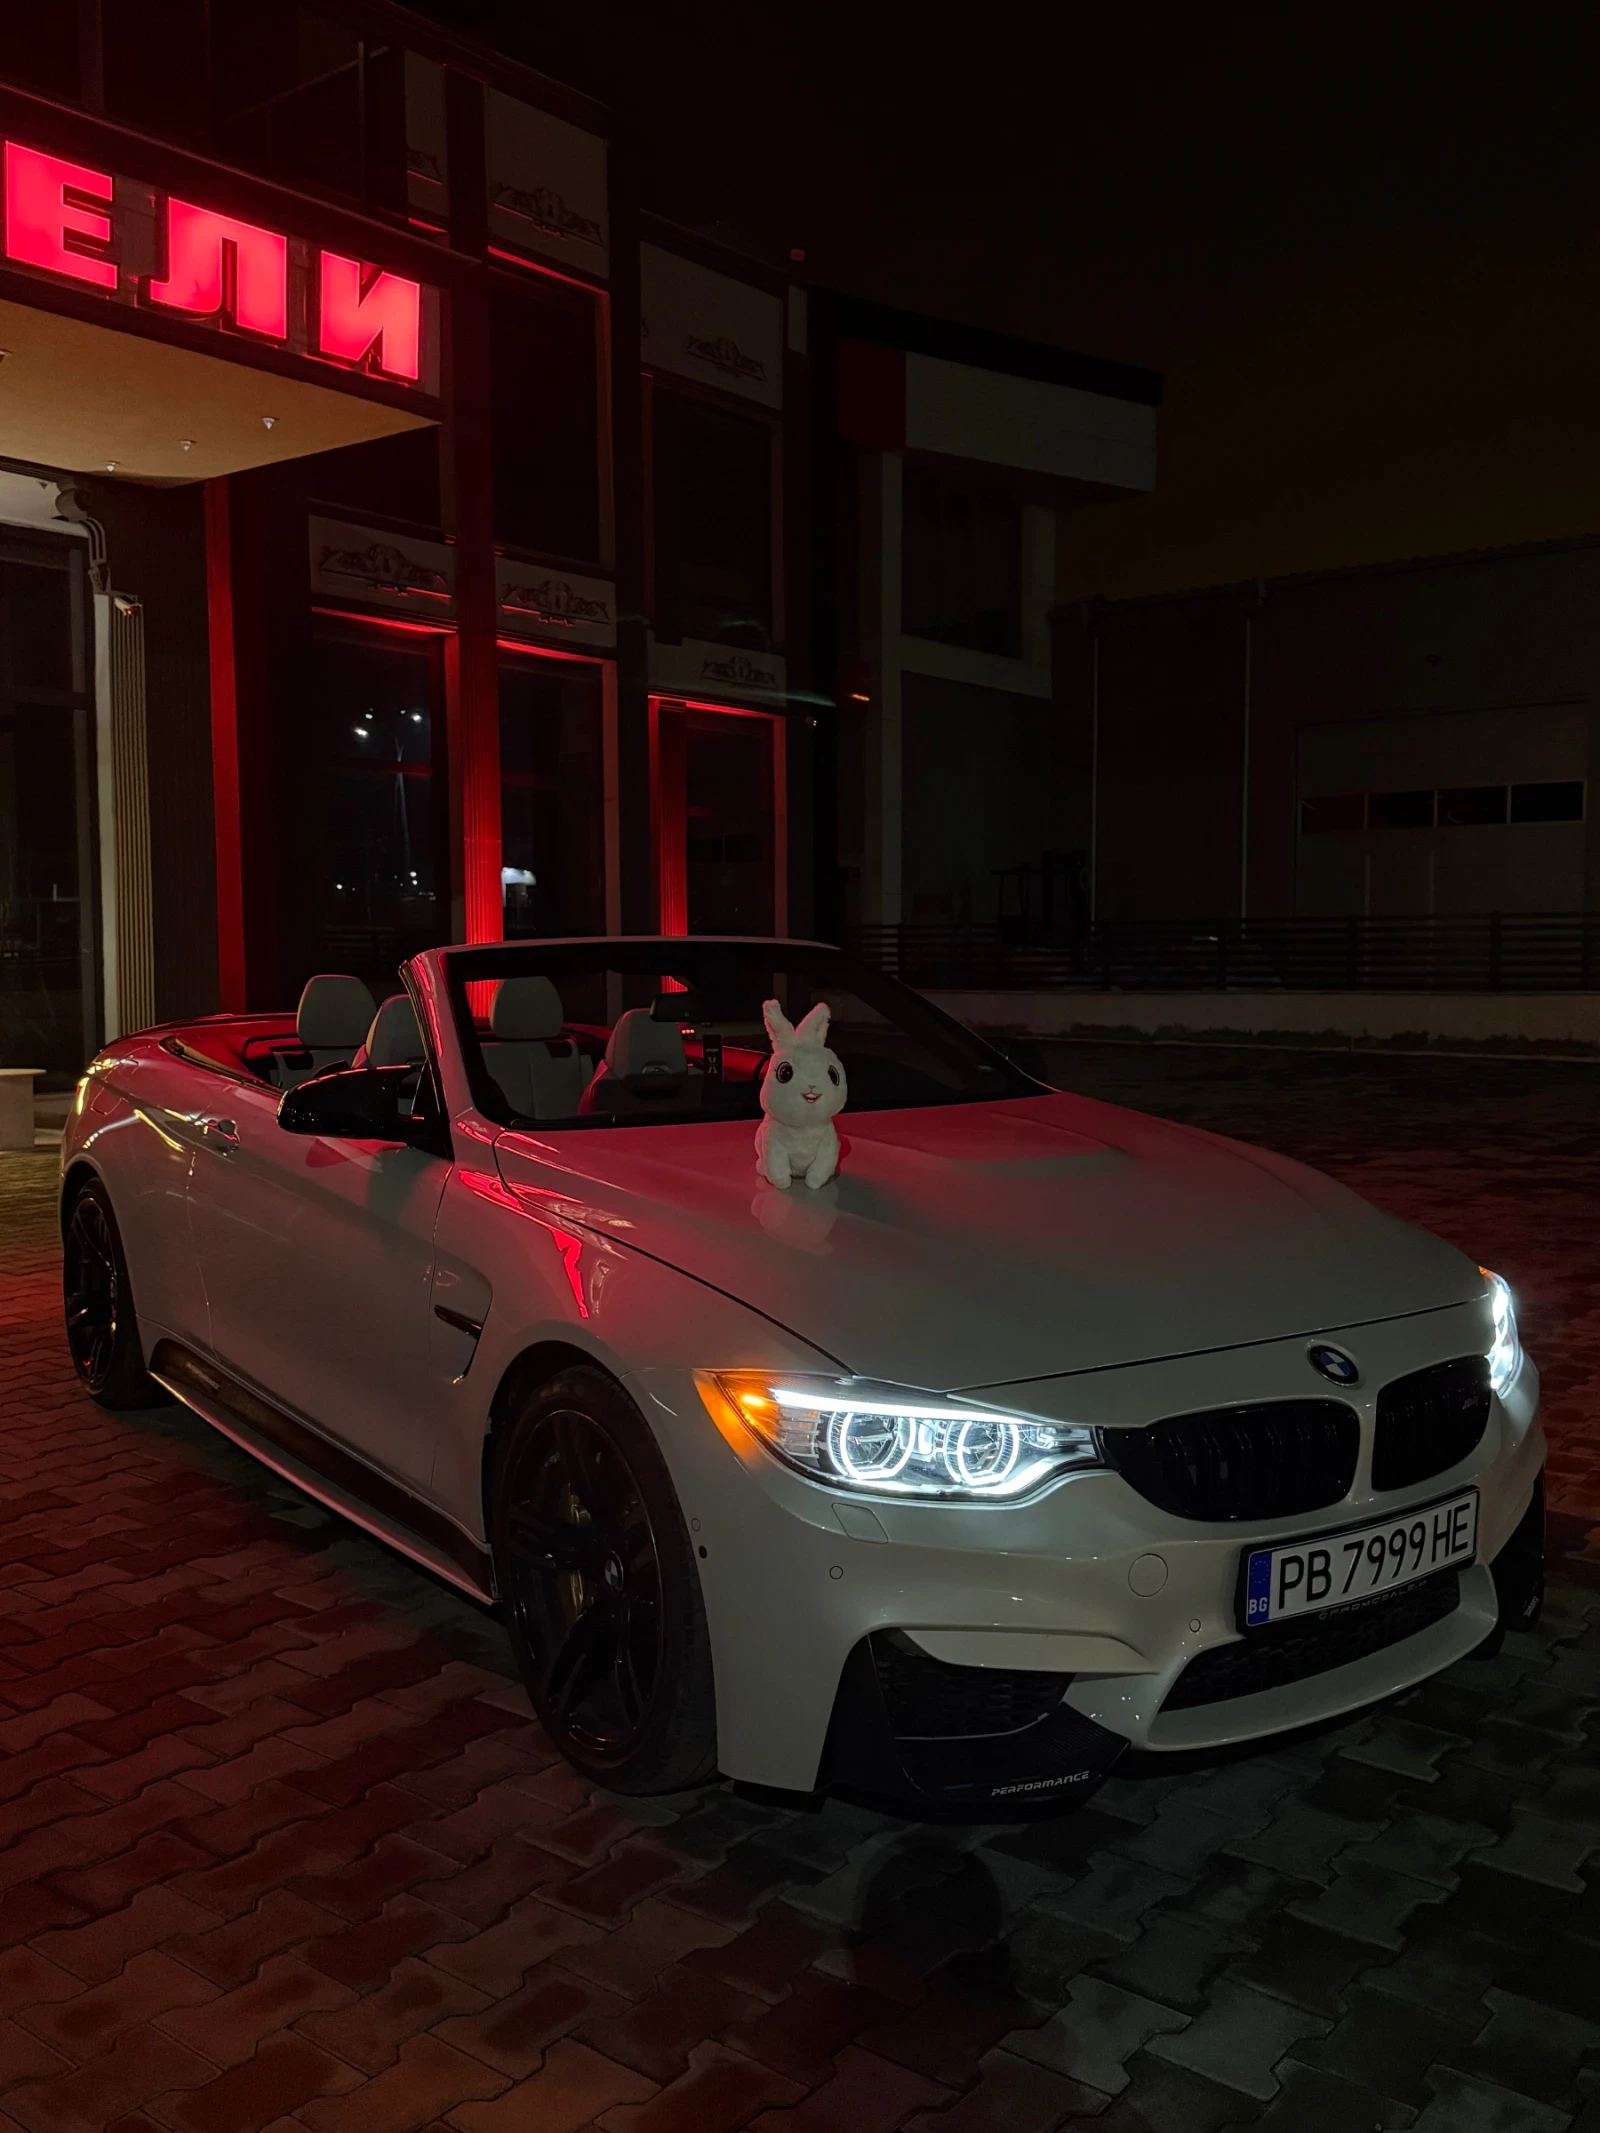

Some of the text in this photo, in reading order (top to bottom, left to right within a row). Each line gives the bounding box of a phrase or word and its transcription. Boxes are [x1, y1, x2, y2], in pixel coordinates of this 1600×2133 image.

[1278, 1502, 1470, 1609] PB 7999 HE
[1248, 1597, 1268, 1614] BG
[991, 1770, 1090, 1796] PERFORMANCE
